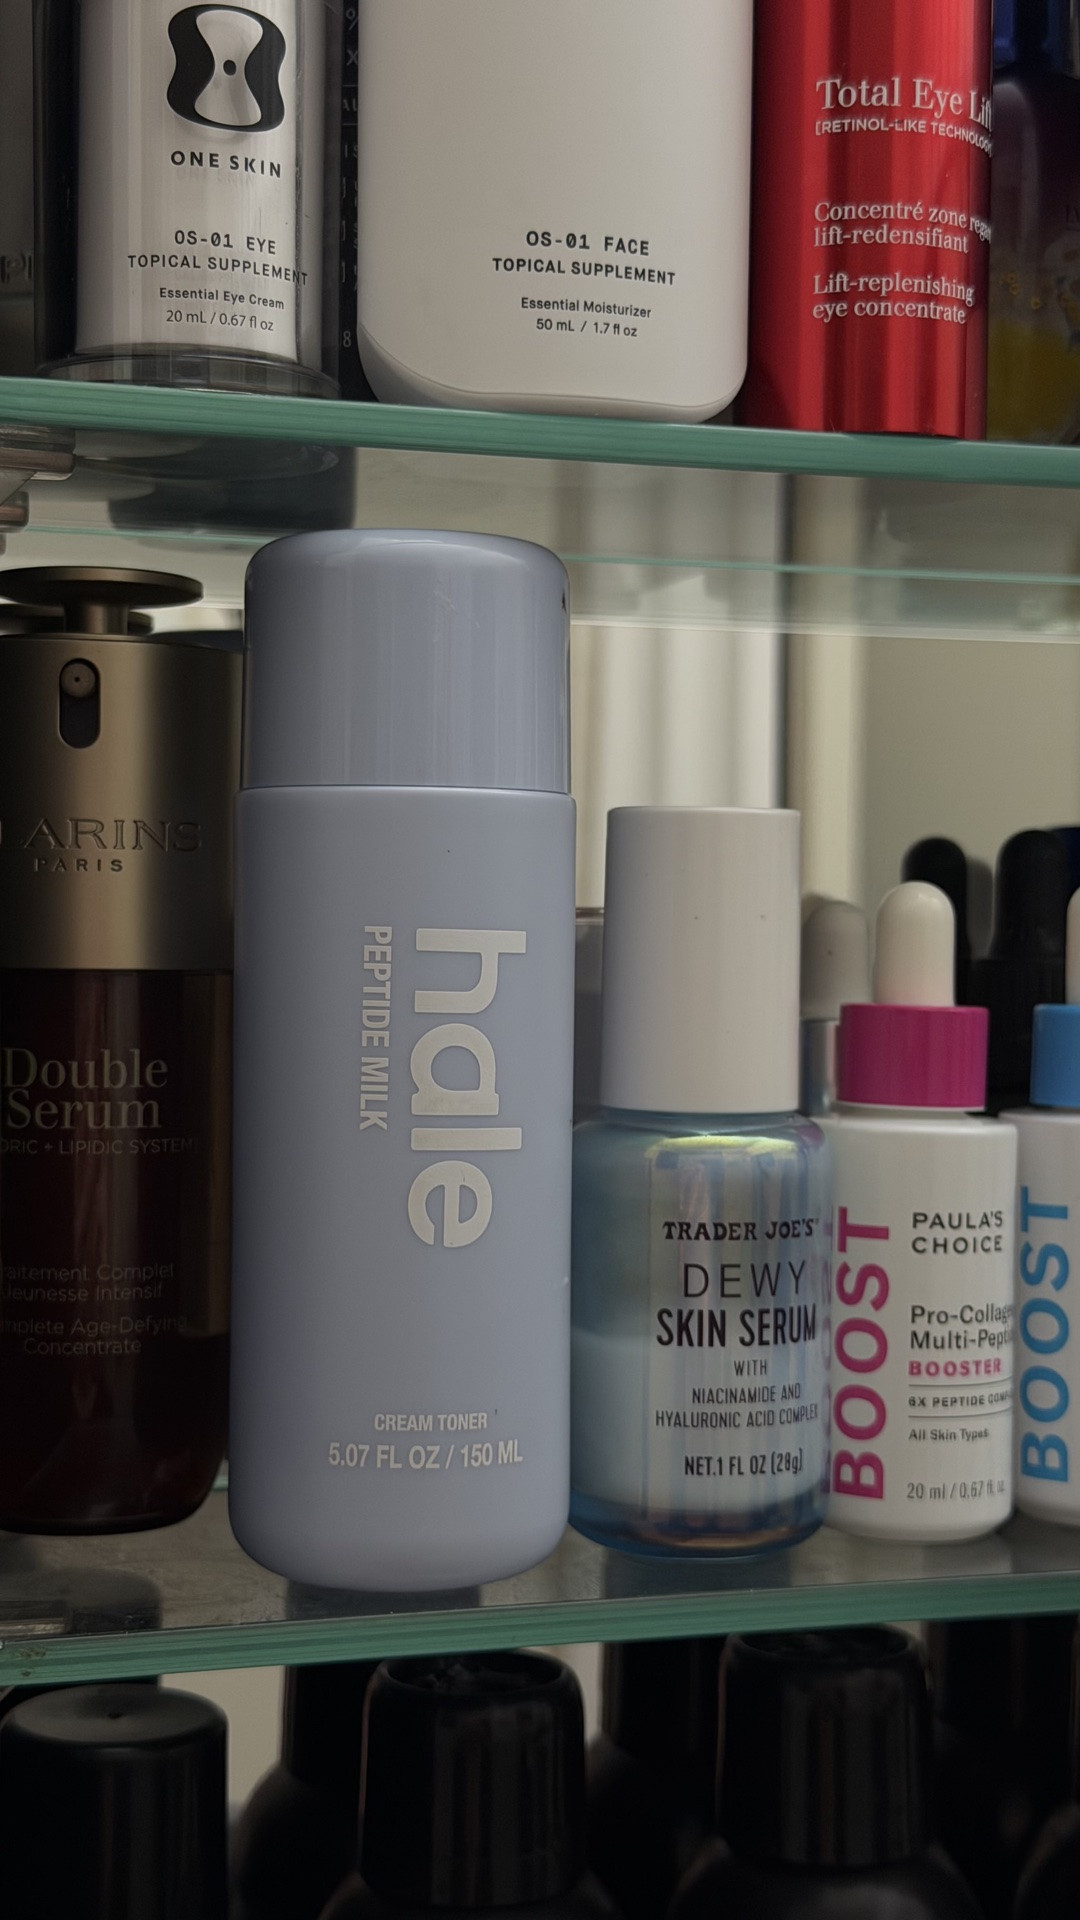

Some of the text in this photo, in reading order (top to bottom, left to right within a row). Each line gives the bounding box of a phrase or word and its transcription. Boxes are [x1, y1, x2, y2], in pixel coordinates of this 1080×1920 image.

[816, 77, 900, 111] Total
[912, 79, 962, 119] Eye
[814, 202, 923, 222] Concentré
[928, 206, 967, 228] zone
[174, 230, 276, 255] OS-01 EYE
[526, 230, 650, 256] OS-01 FACE
[813, 225, 969, 253] lift-redensifiant
[128, 255, 308, 286] TOPICAL SUPPLEMENT
[492, 258, 676, 285] TOPICAL SUPPLEMENT
[159, 287, 285, 310] Essential Eye Cream
[813, 273, 975, 306] Lift-replenishing
[521, 297, 652, 318] Essential Moisturizer
[812, 302, 967, 325] eye concentrate
[166, 310, 274, 331] 20 mL / 0.67 fl oz
[536, 318, 638, 337] 50 mL / 1.7 fl oz
[33, 857, 124, 873] PARIS
[358, 924, 394, 1132] PEPTIDE MILK
[1, 1046, 169, 1089] Double
[407, 927, 527, 1249] hale
[6, 1087, 162, 1130] Serum
[59, 1138, 124, 1155] LIPIDIC
[662, 1220, 757, 1241] TRADER
[911, 1210, 1004, 1230] PAULA'S
[911, 1235, 1003, 1254] CHOICE
[96, 1262, 175, 1282] Complet
[683, 1259, 806, 1298] DEWY
[95, 1282, 163, 1301] Intensif
[656, 1302, 817, 1348] SKIN SERUM
[1019, 1186, 1069, 1482] BOOST
[23, 1338, 143, 1356] Concentrate
[833, 1206, 889, 1499] BOOST
[733, 1359, 768, 1378] WITH
[908, 1358, 1003, 1377] BOOSTER
[692, 1382, 802, 1405] NIACINAMIDE AND
[932, 1395, 985, 1408] PEPTIDE
[374, 1412, 488, 1431] CREAM TONER
[655, 1402, 820, 1429] HYALURONIC ACID COMPLEX
[908, 1427, 989, 1442] All Skin Types
[328, 1439, 524, 1470] 5.07 FL OZ / 150 ML
[728, 1455, 745, 1476] FL
[749, 1454, 767, 1475] OZ
[770, 1447, 804, 1476] (28g)
[907, 1482, 924, 1499] 20
[929, 1482, 946, 1500] ml
[949, 1482, 957, 1499] /
[959, 1481, 984, 1499] 0.67
